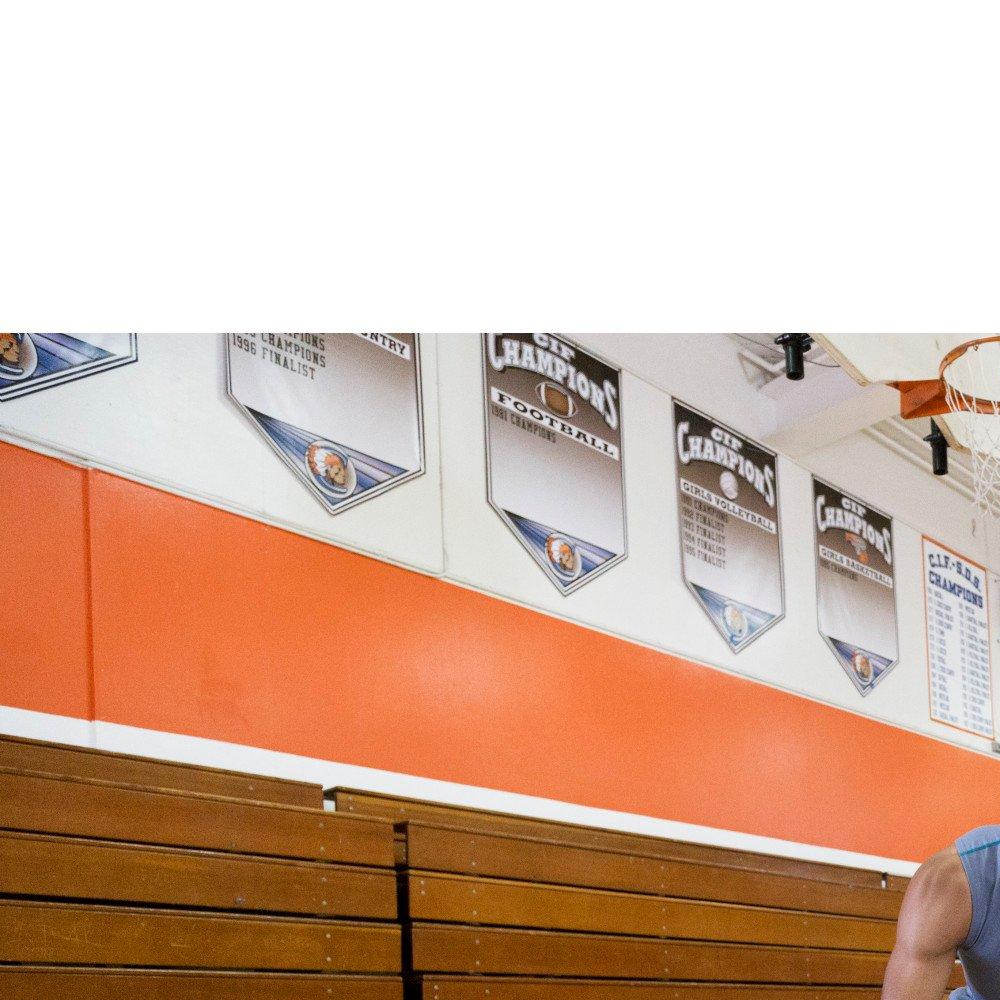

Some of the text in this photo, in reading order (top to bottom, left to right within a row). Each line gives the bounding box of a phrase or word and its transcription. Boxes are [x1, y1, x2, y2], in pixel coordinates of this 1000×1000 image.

[232, 333, 316, 380] 1996 FINALIST
[261, 333, 326, 367] CHAMPIONS
[488, 333, 617, 430] CHAMPIONS
[498, 392, 615, 456] FOOTBALL
[711, 427, 743, 452] CIF
[677, 421, 775, 508] CHAMPIONS
[683, 482, 773, 532] GIRLS VOLLEYBALL
[816, 494, 892, 567] CHAMPIONS
[929, 571, 983, 608] CHAMPIONS
